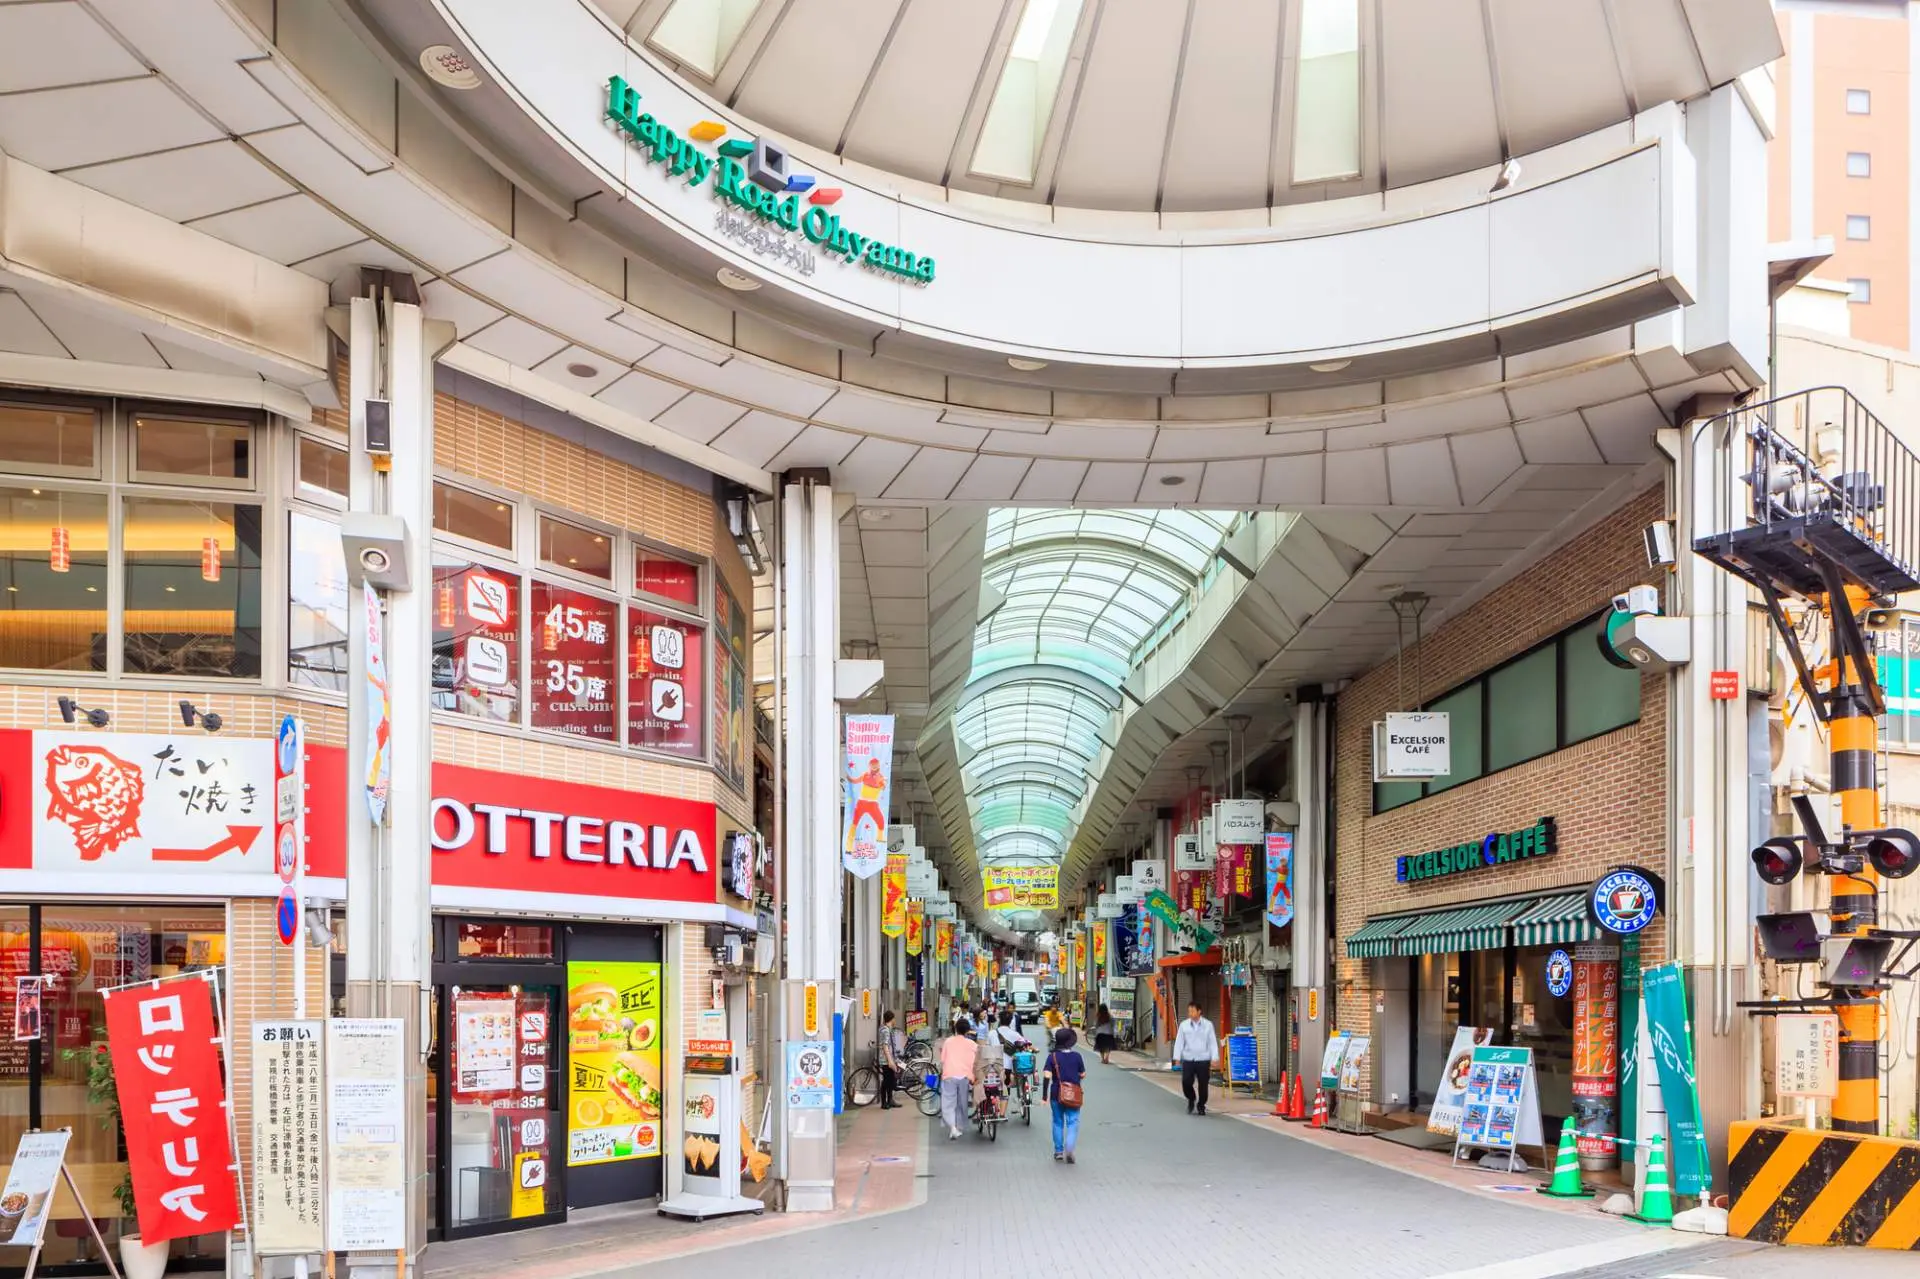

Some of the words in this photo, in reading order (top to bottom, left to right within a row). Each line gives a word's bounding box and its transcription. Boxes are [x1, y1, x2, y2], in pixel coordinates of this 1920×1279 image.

[606, 74, 715, 188] Happy
[715, 154, 799, 233] Road
[801, 205, 937, 286] Ohyama
[544, 603, 606, 645] 45席
[547, 659, 606, 700] 35席
[848, 733, 891, 744] Summer
[848, 744, 870, 755] Sale
[1390, 734, 1446, 745] EXCELSIOR
[1405, 744, 1430, 754] CAFÉ
[152, 744, 228, 780] たい
[179, 780, 258, 815] 焼き
[431, 796, 709, 873] OTTERIA
[281, 841, 294, 866] 30
[1397, 841, 1481, 882] EXCELSIOR
[1597, 875, 1654, 902] EXCELSIOR
[620, 986, 655, 1010] 夏エビ
[263, 1027, 311, 1041] お願い
[137, 994, 208, 1222] ロッテリア
